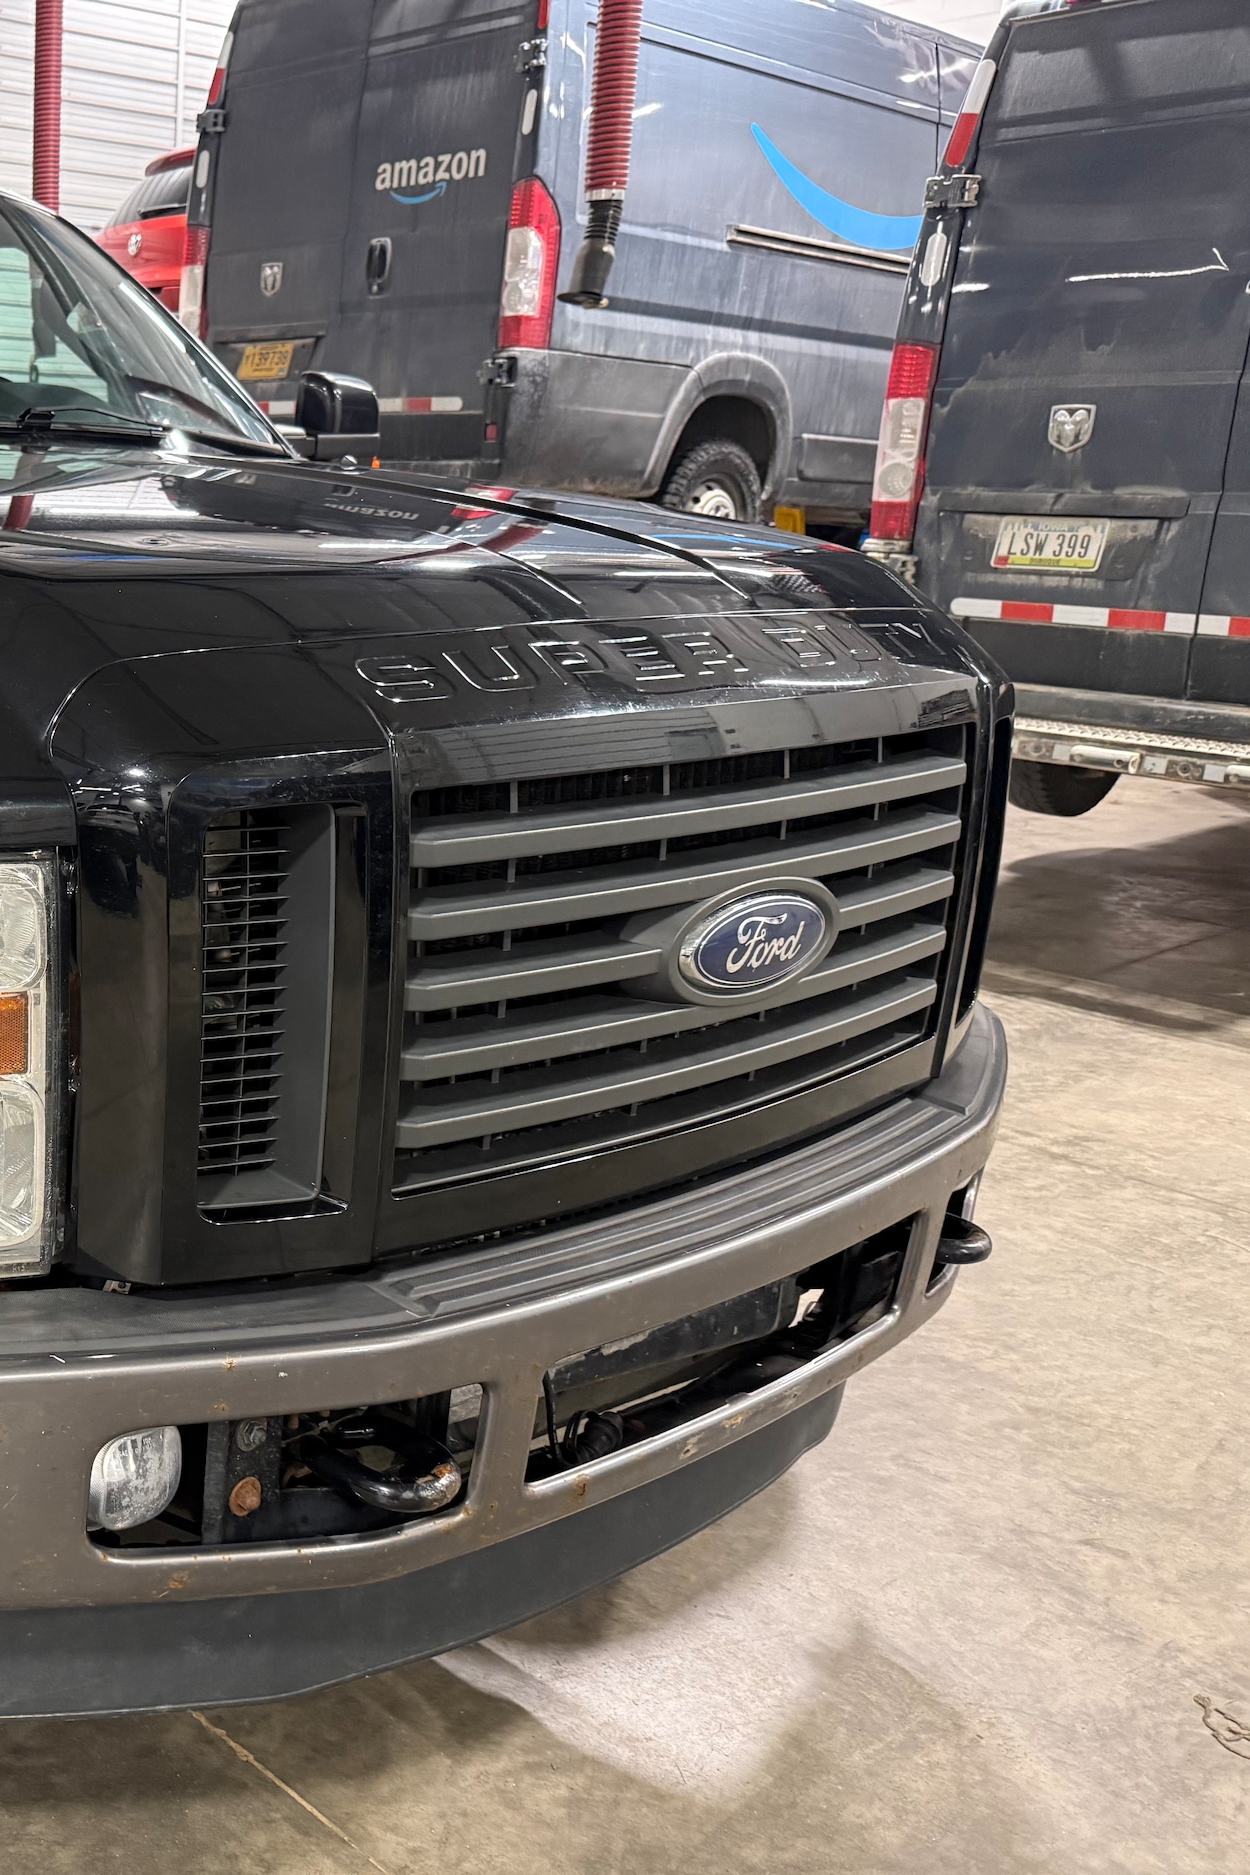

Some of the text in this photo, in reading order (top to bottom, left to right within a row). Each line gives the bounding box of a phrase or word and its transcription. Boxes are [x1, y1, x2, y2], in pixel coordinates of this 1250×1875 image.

[374, 147, 487, 191] amazon
[1007, 531, 1092, 559] LSW 399
[1038, 522, 1069, 532] IOWA
[354, 620, 947, 703] SUPER DUTY
[726, 912, 806, 974] Ford
